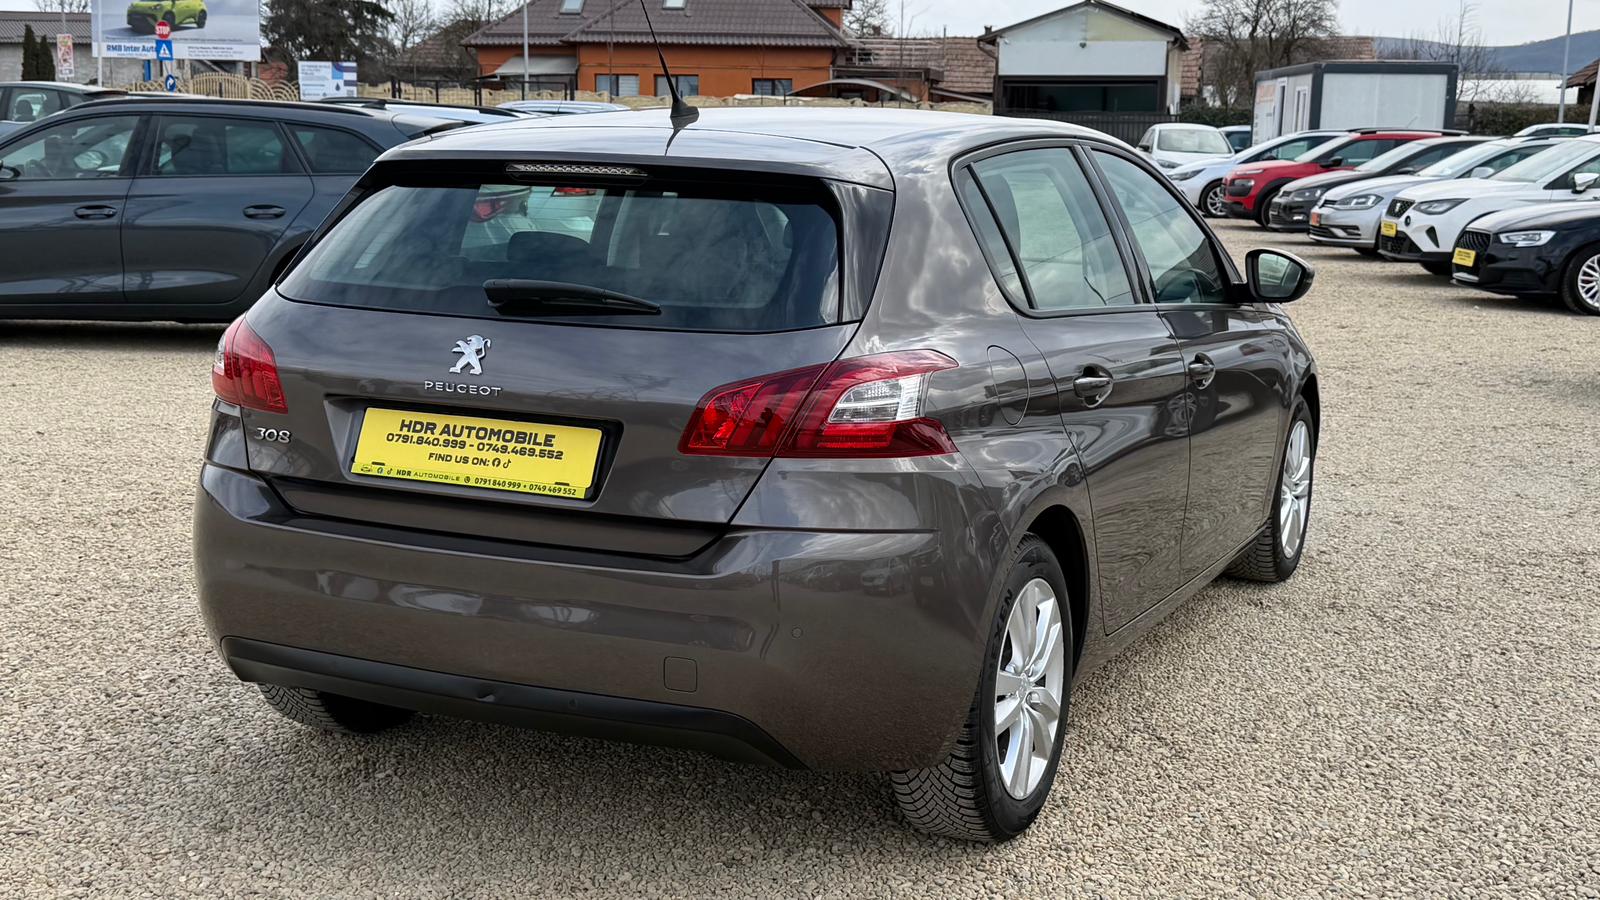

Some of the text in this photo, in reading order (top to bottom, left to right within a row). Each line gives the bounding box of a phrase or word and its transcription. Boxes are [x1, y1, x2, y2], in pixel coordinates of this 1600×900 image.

[155, 26, 170, 35] STOP
[123, 44, 140, 52] Inter
[424, 380, 502, 397] PEUGEOT
[254, 427, 291, 444] 308
[399, 418, 556, 448] HDR AUTOMOBILE
[386, 432, 467, 450] 0791.840.999
[476, 442, 564, 460] 0749.469.552
[428, 452, 490, 467] FIND US ON:
[396, 468, 412, 477] HDR
[413, 471, 460, 482] AUTOMOBILE
